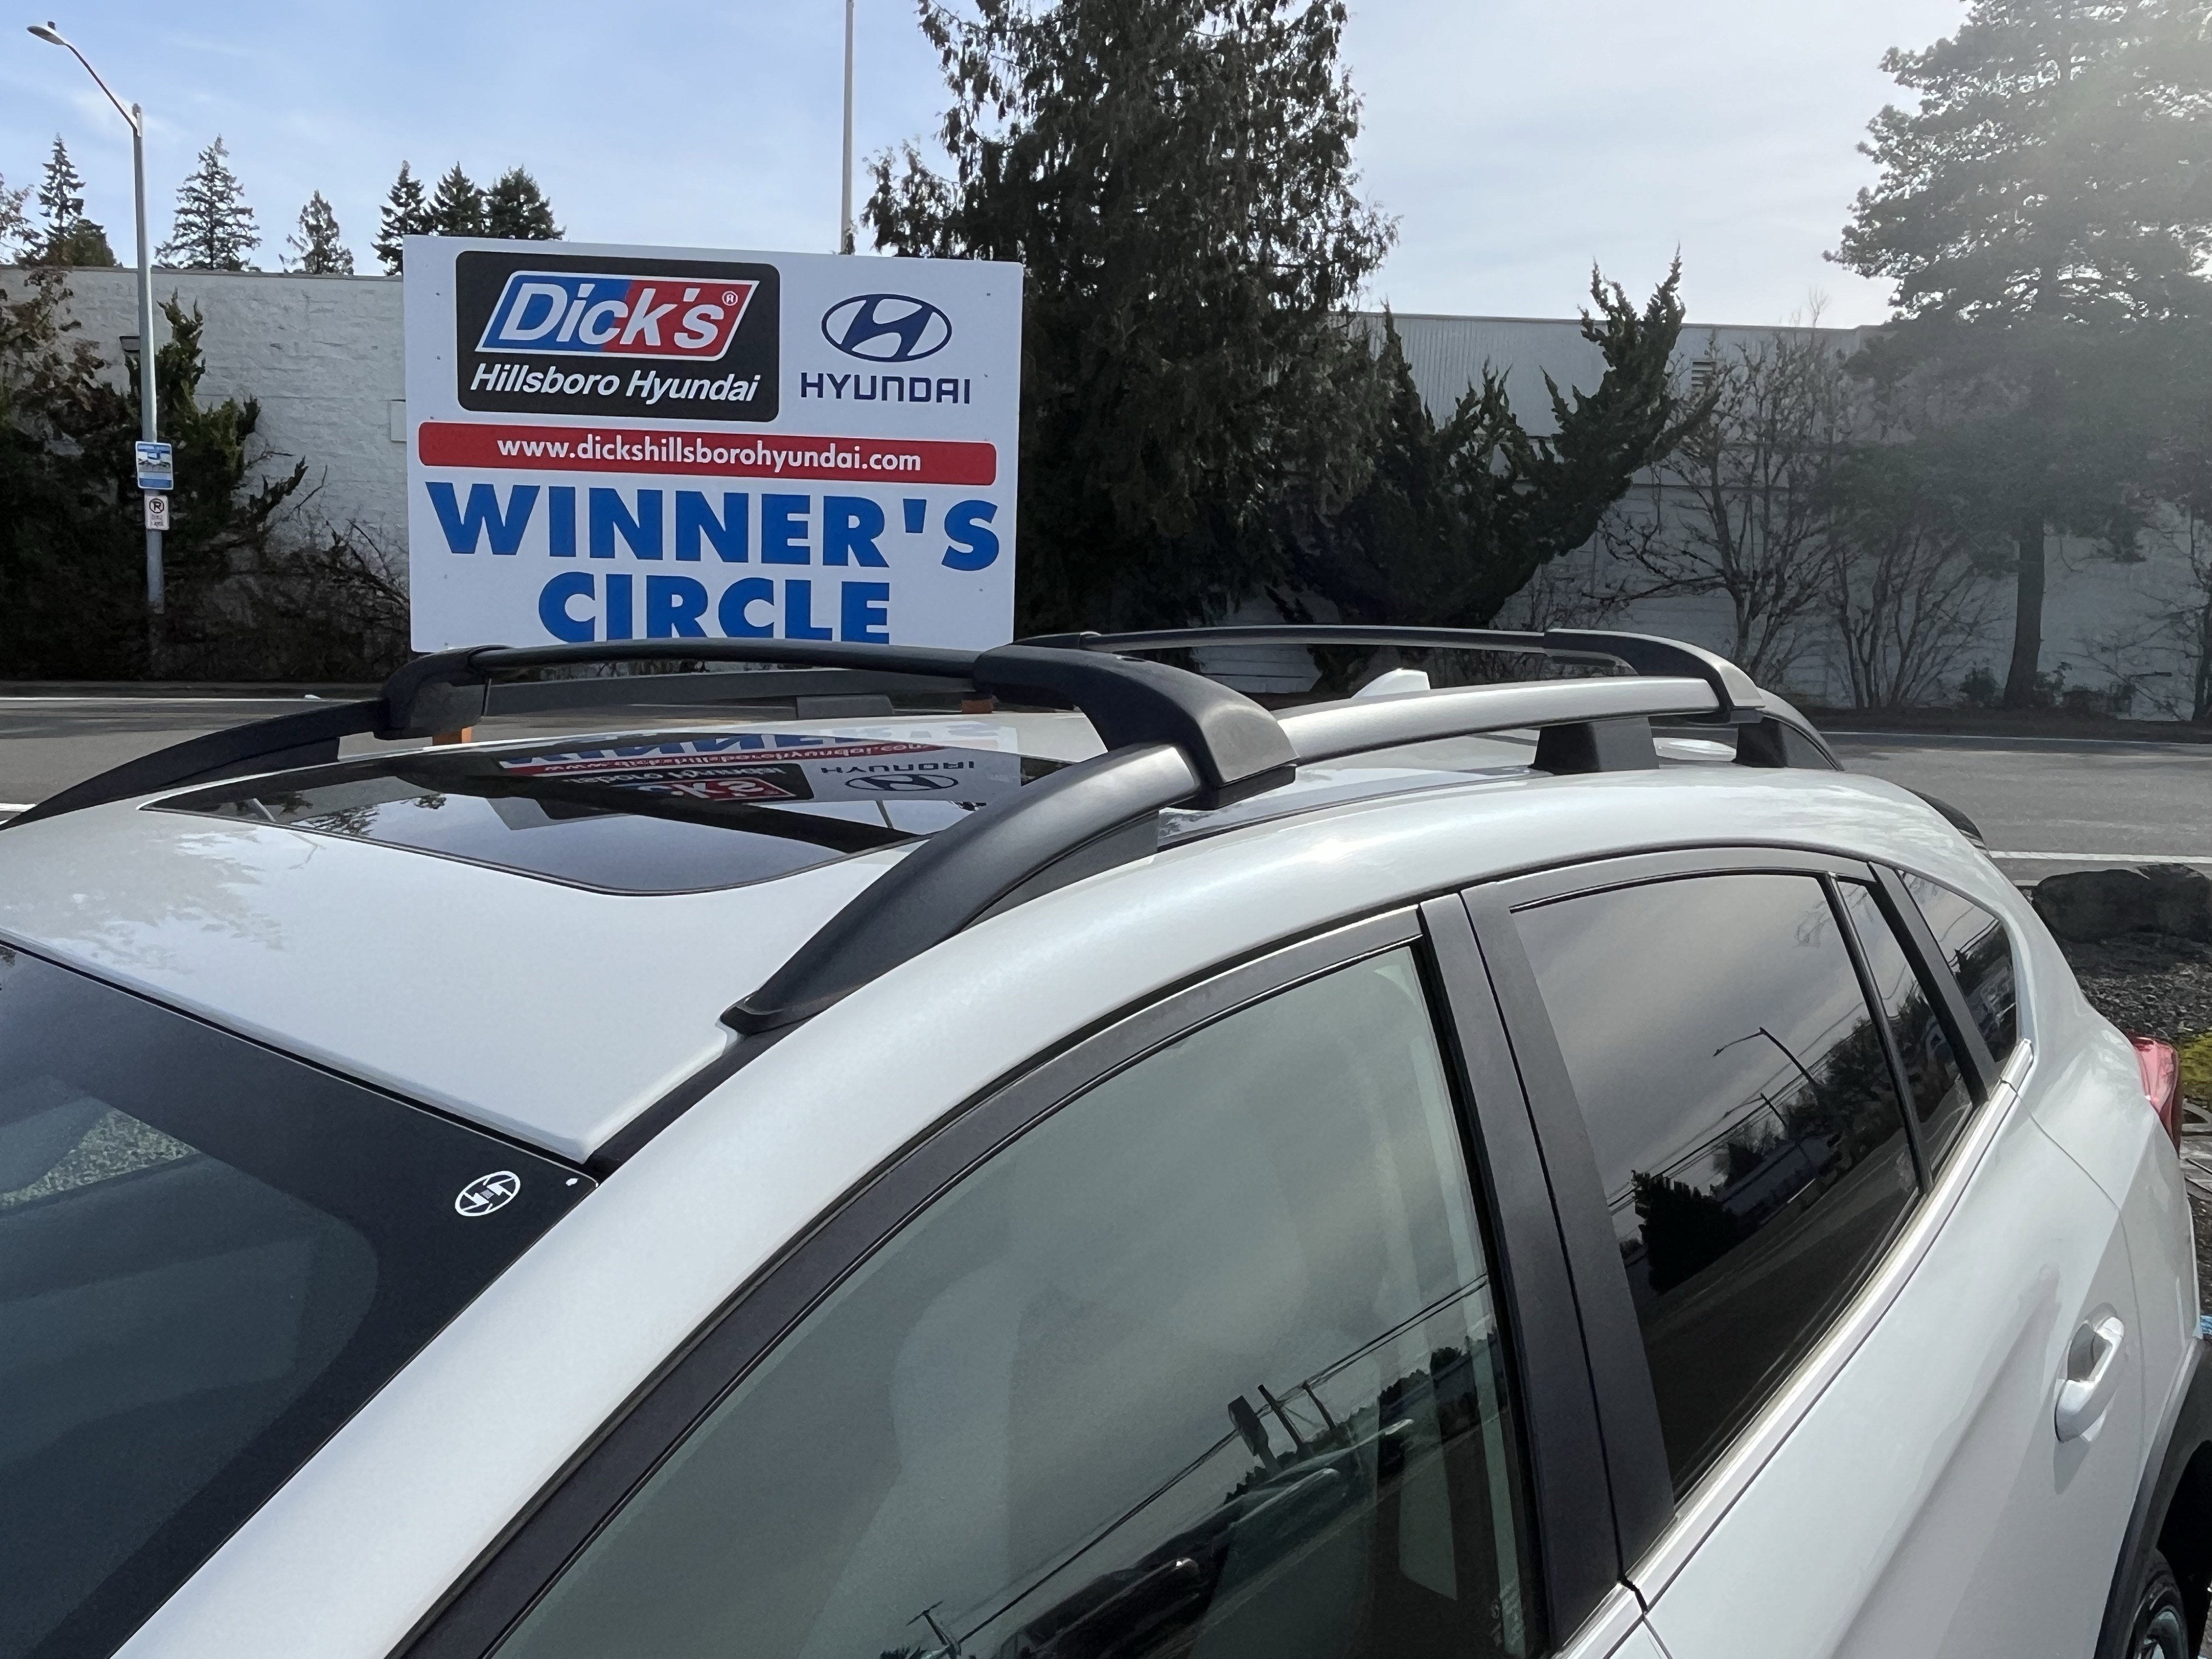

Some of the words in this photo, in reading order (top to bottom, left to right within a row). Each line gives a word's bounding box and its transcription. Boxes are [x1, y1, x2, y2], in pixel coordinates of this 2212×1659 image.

[470, 363, 619, 396] Hillsboro
[626, 370, 760, 405] Hyundai
[802, 372, 970, 405] HYUNDAI
[498, 435, 922, 475] www.dickshillsborohyundai.com
[425, 482, 1000, 572] WINNER'S
[538, 571, 890, 645] CIRCLE
